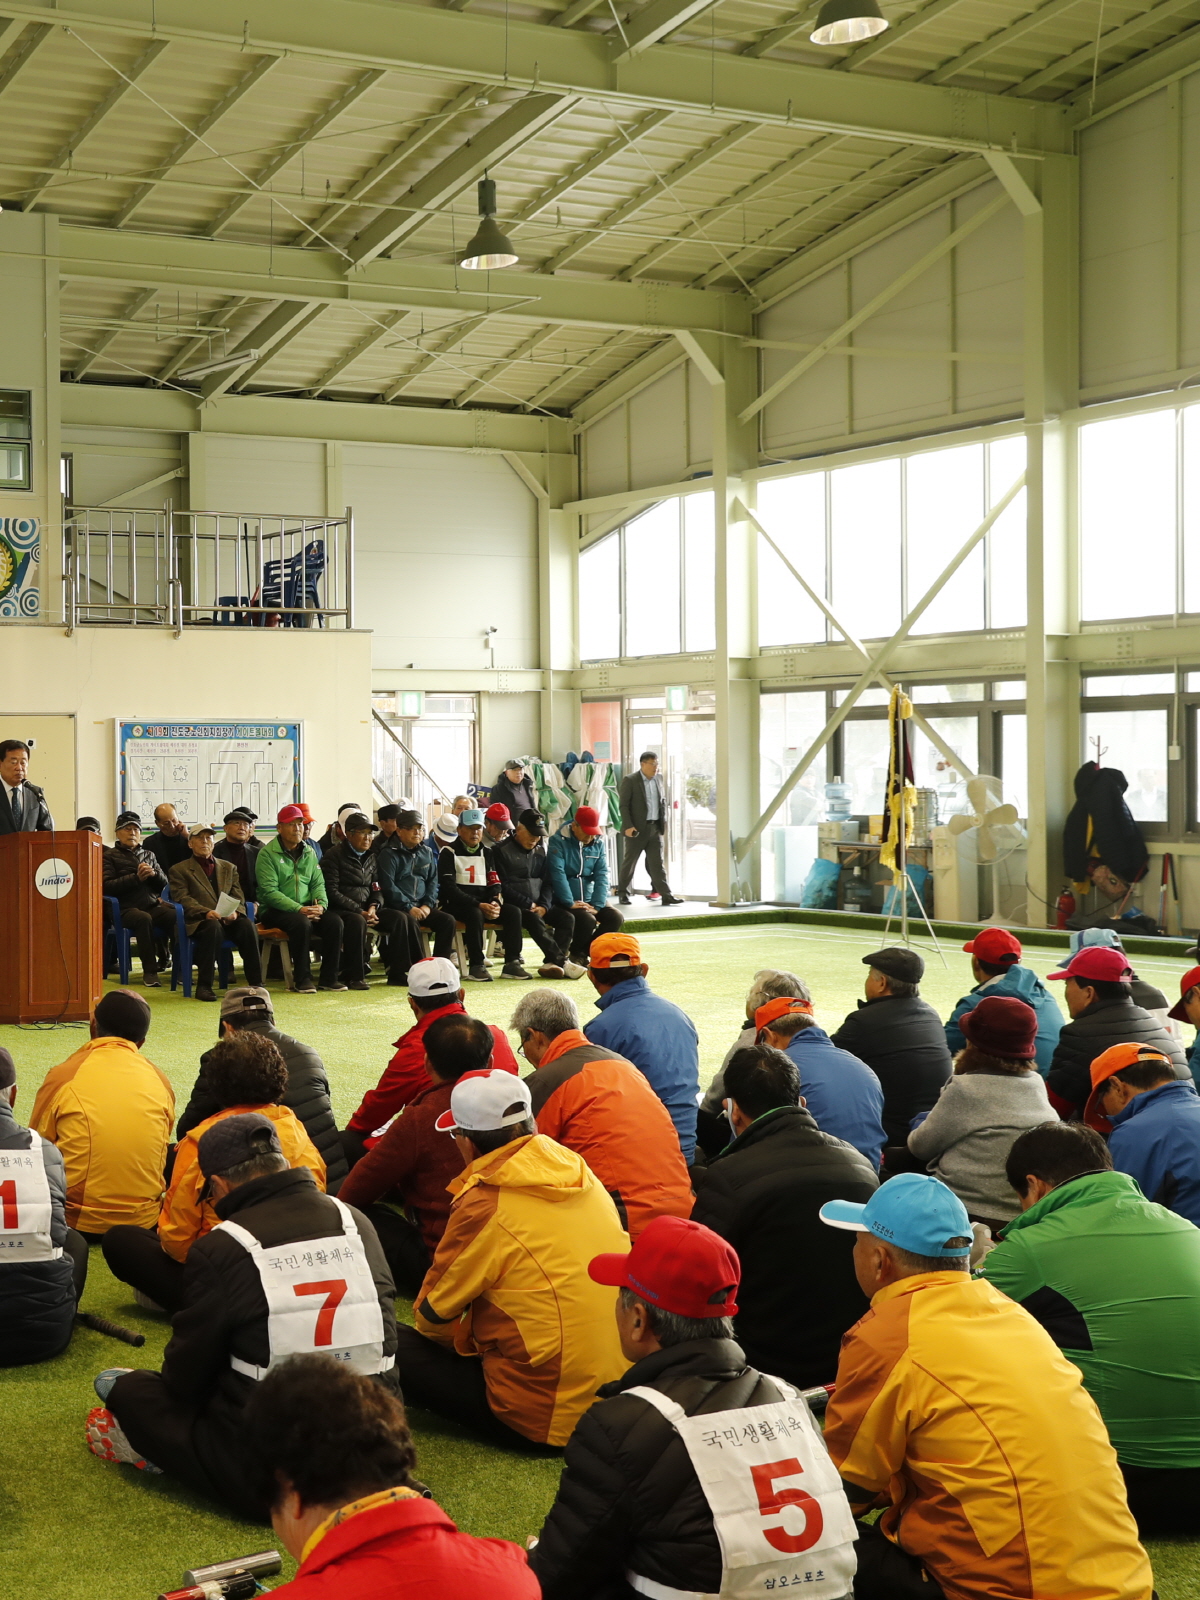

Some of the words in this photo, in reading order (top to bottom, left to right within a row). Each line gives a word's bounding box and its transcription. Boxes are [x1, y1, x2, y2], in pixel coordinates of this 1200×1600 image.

[39, 877, 66, 887] Jindo
[464, 865, 475, 884] 1
[268, 1246, 355, 1272] 국민생활체육
[292, 1278, 348, 1347] 7
[701, 1415, 804, 1450] 국민생활체육
[749, 1456, 824, 1554] 5
[763, 1569, 826, 1590] 삼오스포츠
